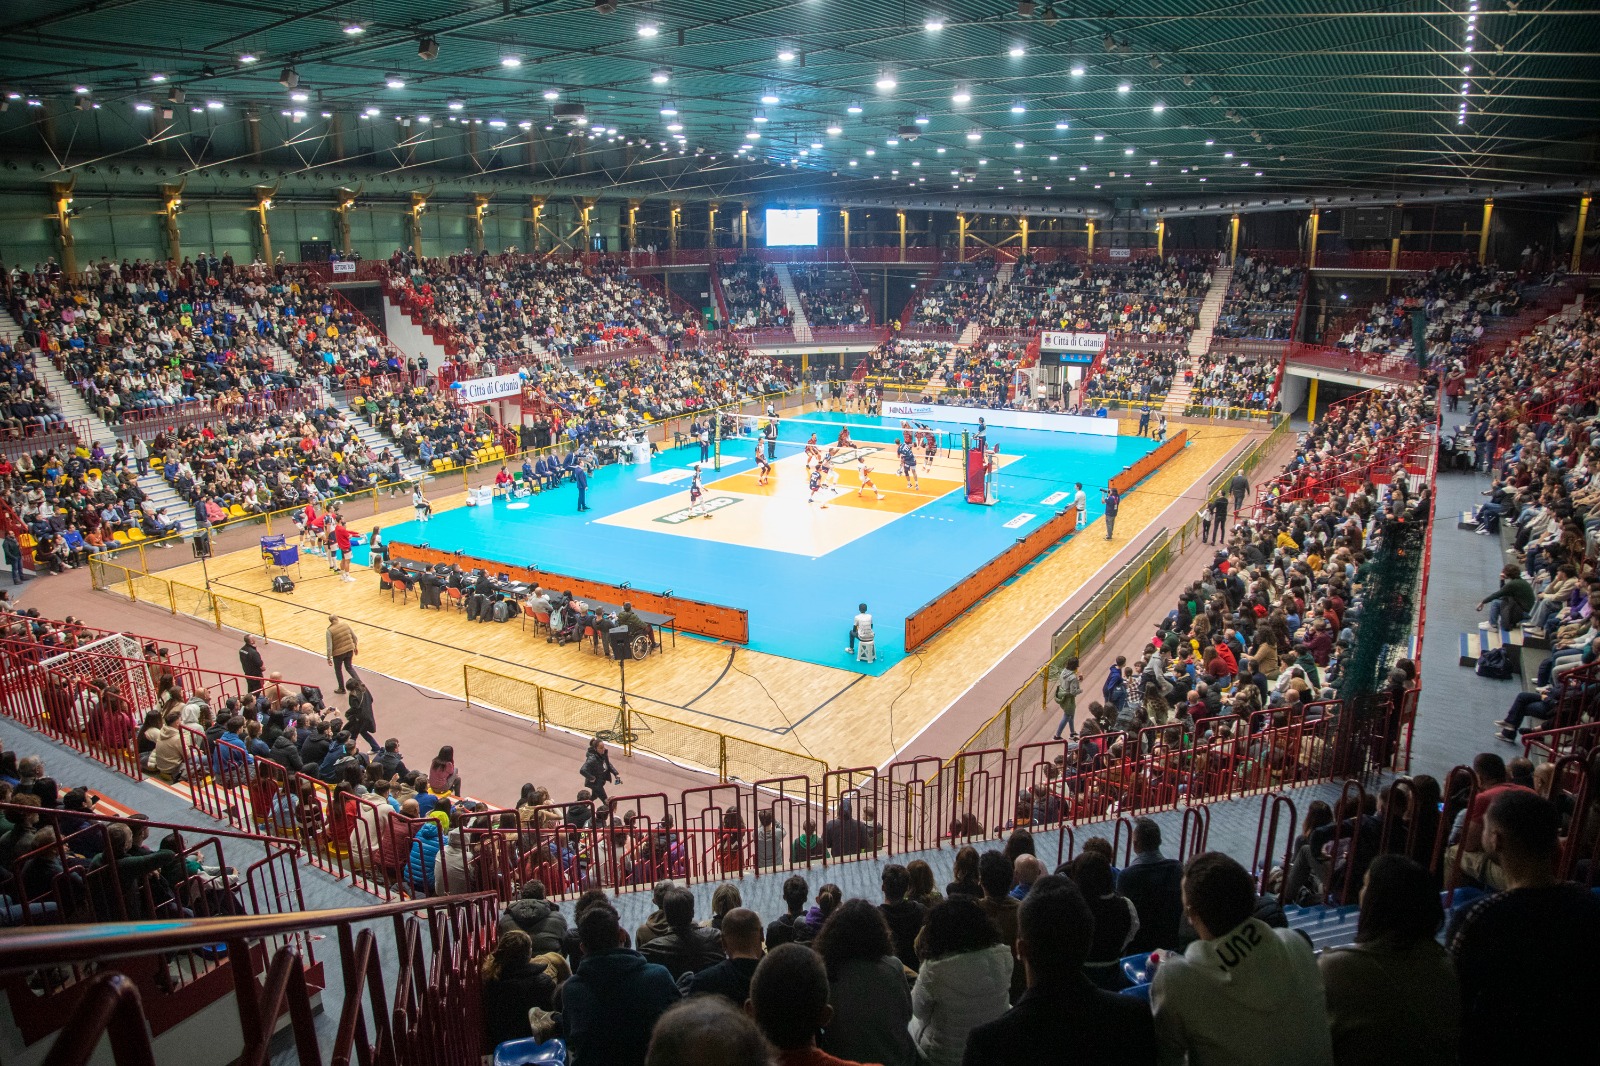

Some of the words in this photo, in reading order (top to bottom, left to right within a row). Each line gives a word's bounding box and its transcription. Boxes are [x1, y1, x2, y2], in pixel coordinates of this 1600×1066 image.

[1053, 335, 1069, 346] Città
[1070, 335, 1077, 347] di
[1078, 336, 1104, 348] Catania
[469, 383, 486, 398] Città
[486, 382, 494, 395] di
[494, 378, 519, 394] Catania
